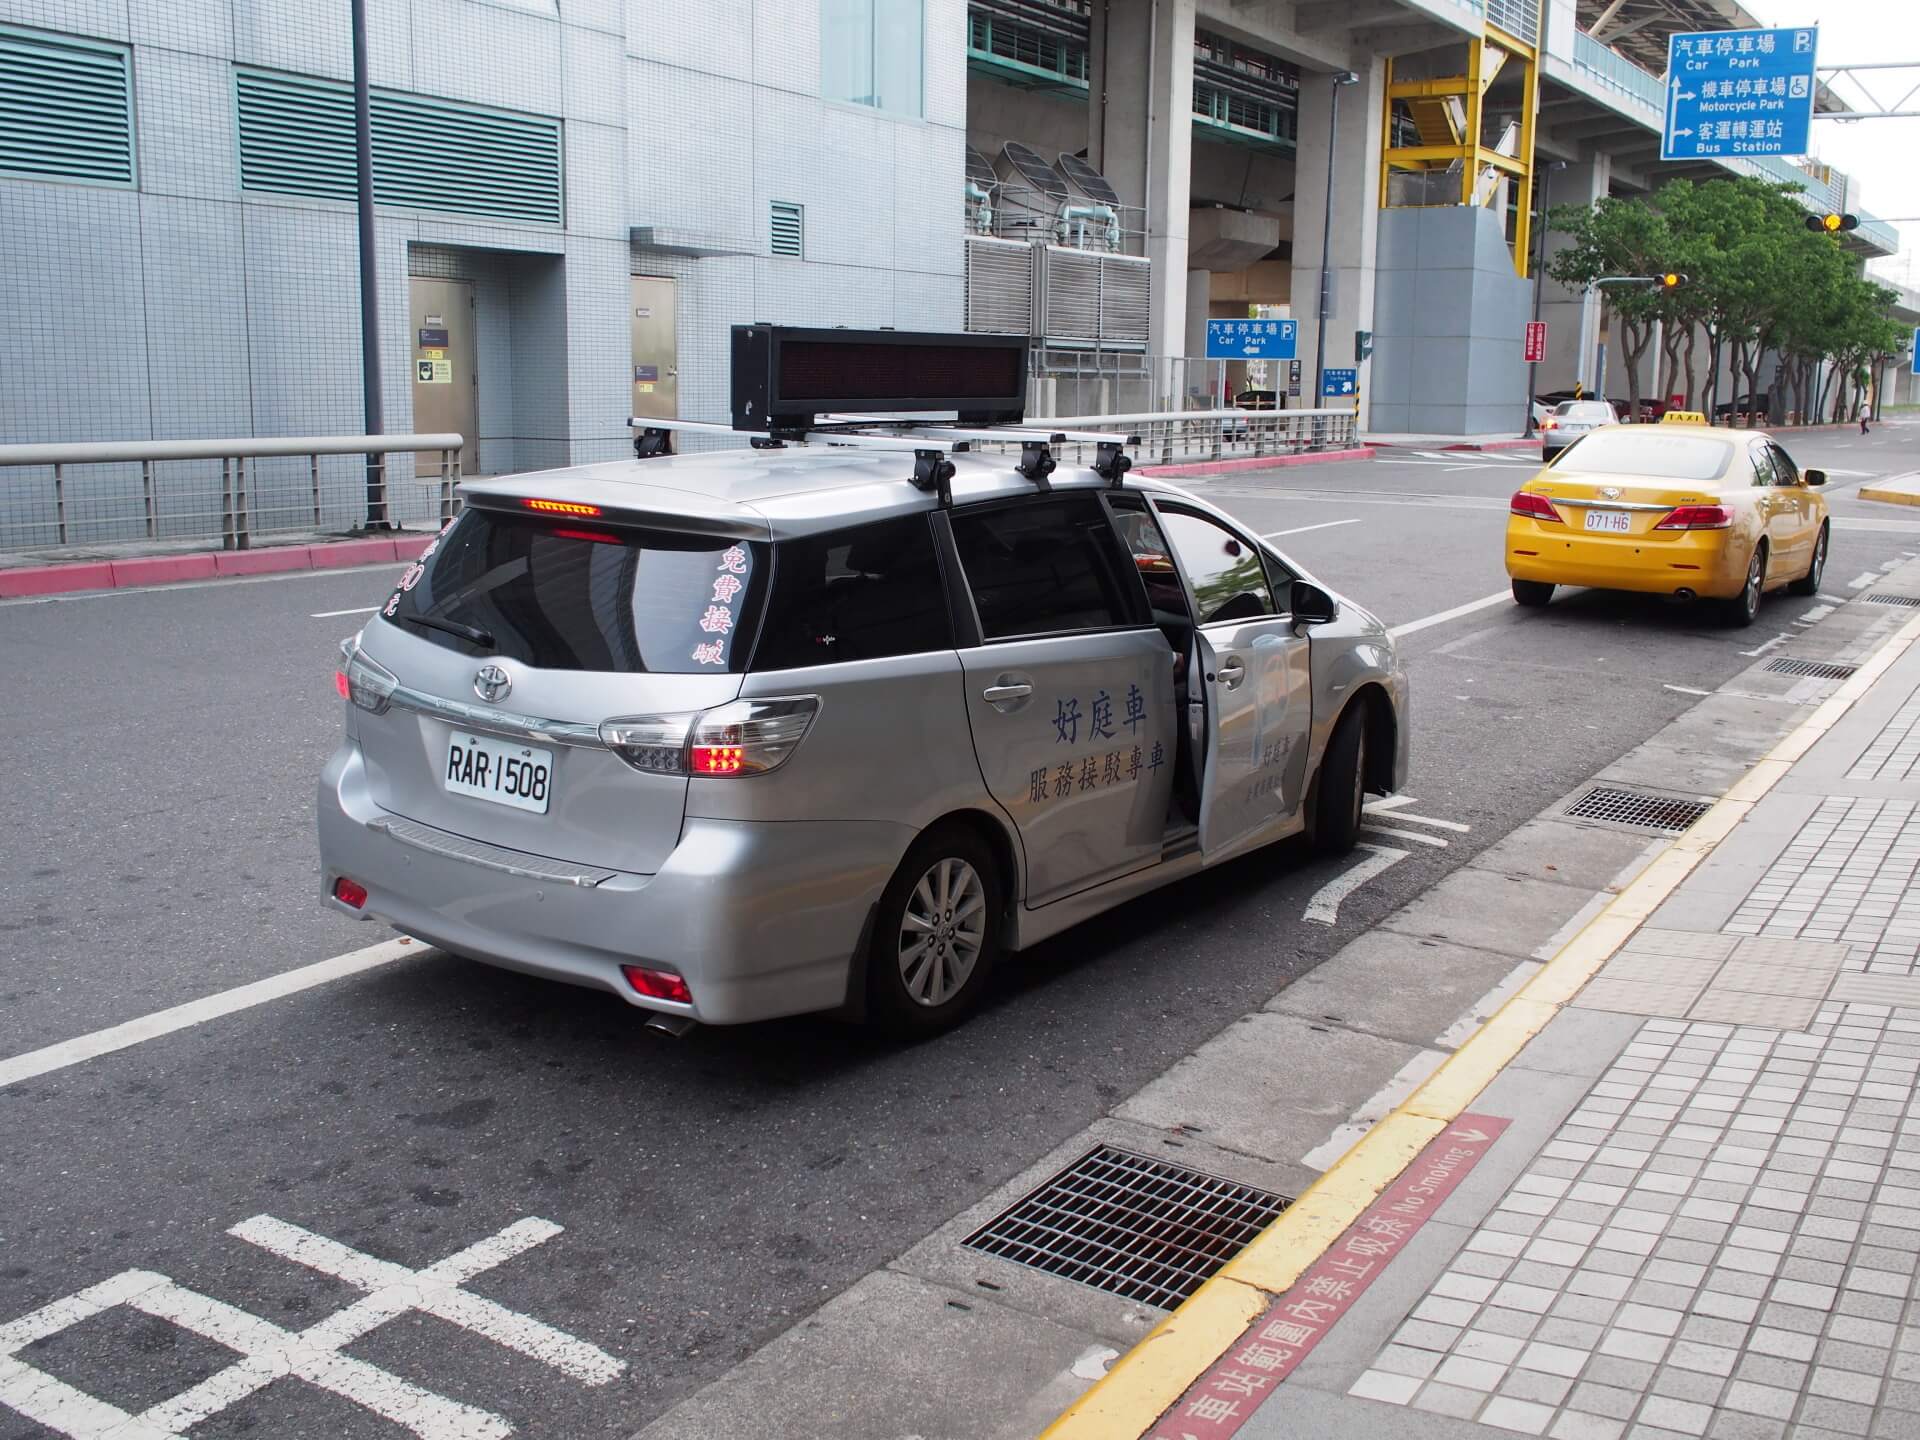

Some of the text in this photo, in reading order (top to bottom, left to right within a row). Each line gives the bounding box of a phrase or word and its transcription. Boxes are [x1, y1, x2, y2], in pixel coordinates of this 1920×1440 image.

[1675, 34, 1776, 58] 汽車停車場
[1686, 57, 1760, 71] Car Park
[1701, 77, 1786, 99] 機車停車場
[1700, 99, 1785, 114] Motorcycle Park
[1697, 119, 1784, 141] 客運轉運站
[1696, 140, 1781, 153] Bus Station
[1218, 336, 1266, 345] Car Park
[1668, 413, 1699, 422] TAXI
[1052, 684, 1147, 745] 好庭車
[1029, 740, 1165, 803] 服務接駁專車
[1391, 1196, 1425, 1214] No
[1408, 1147, 1475, 1195] Smoking
